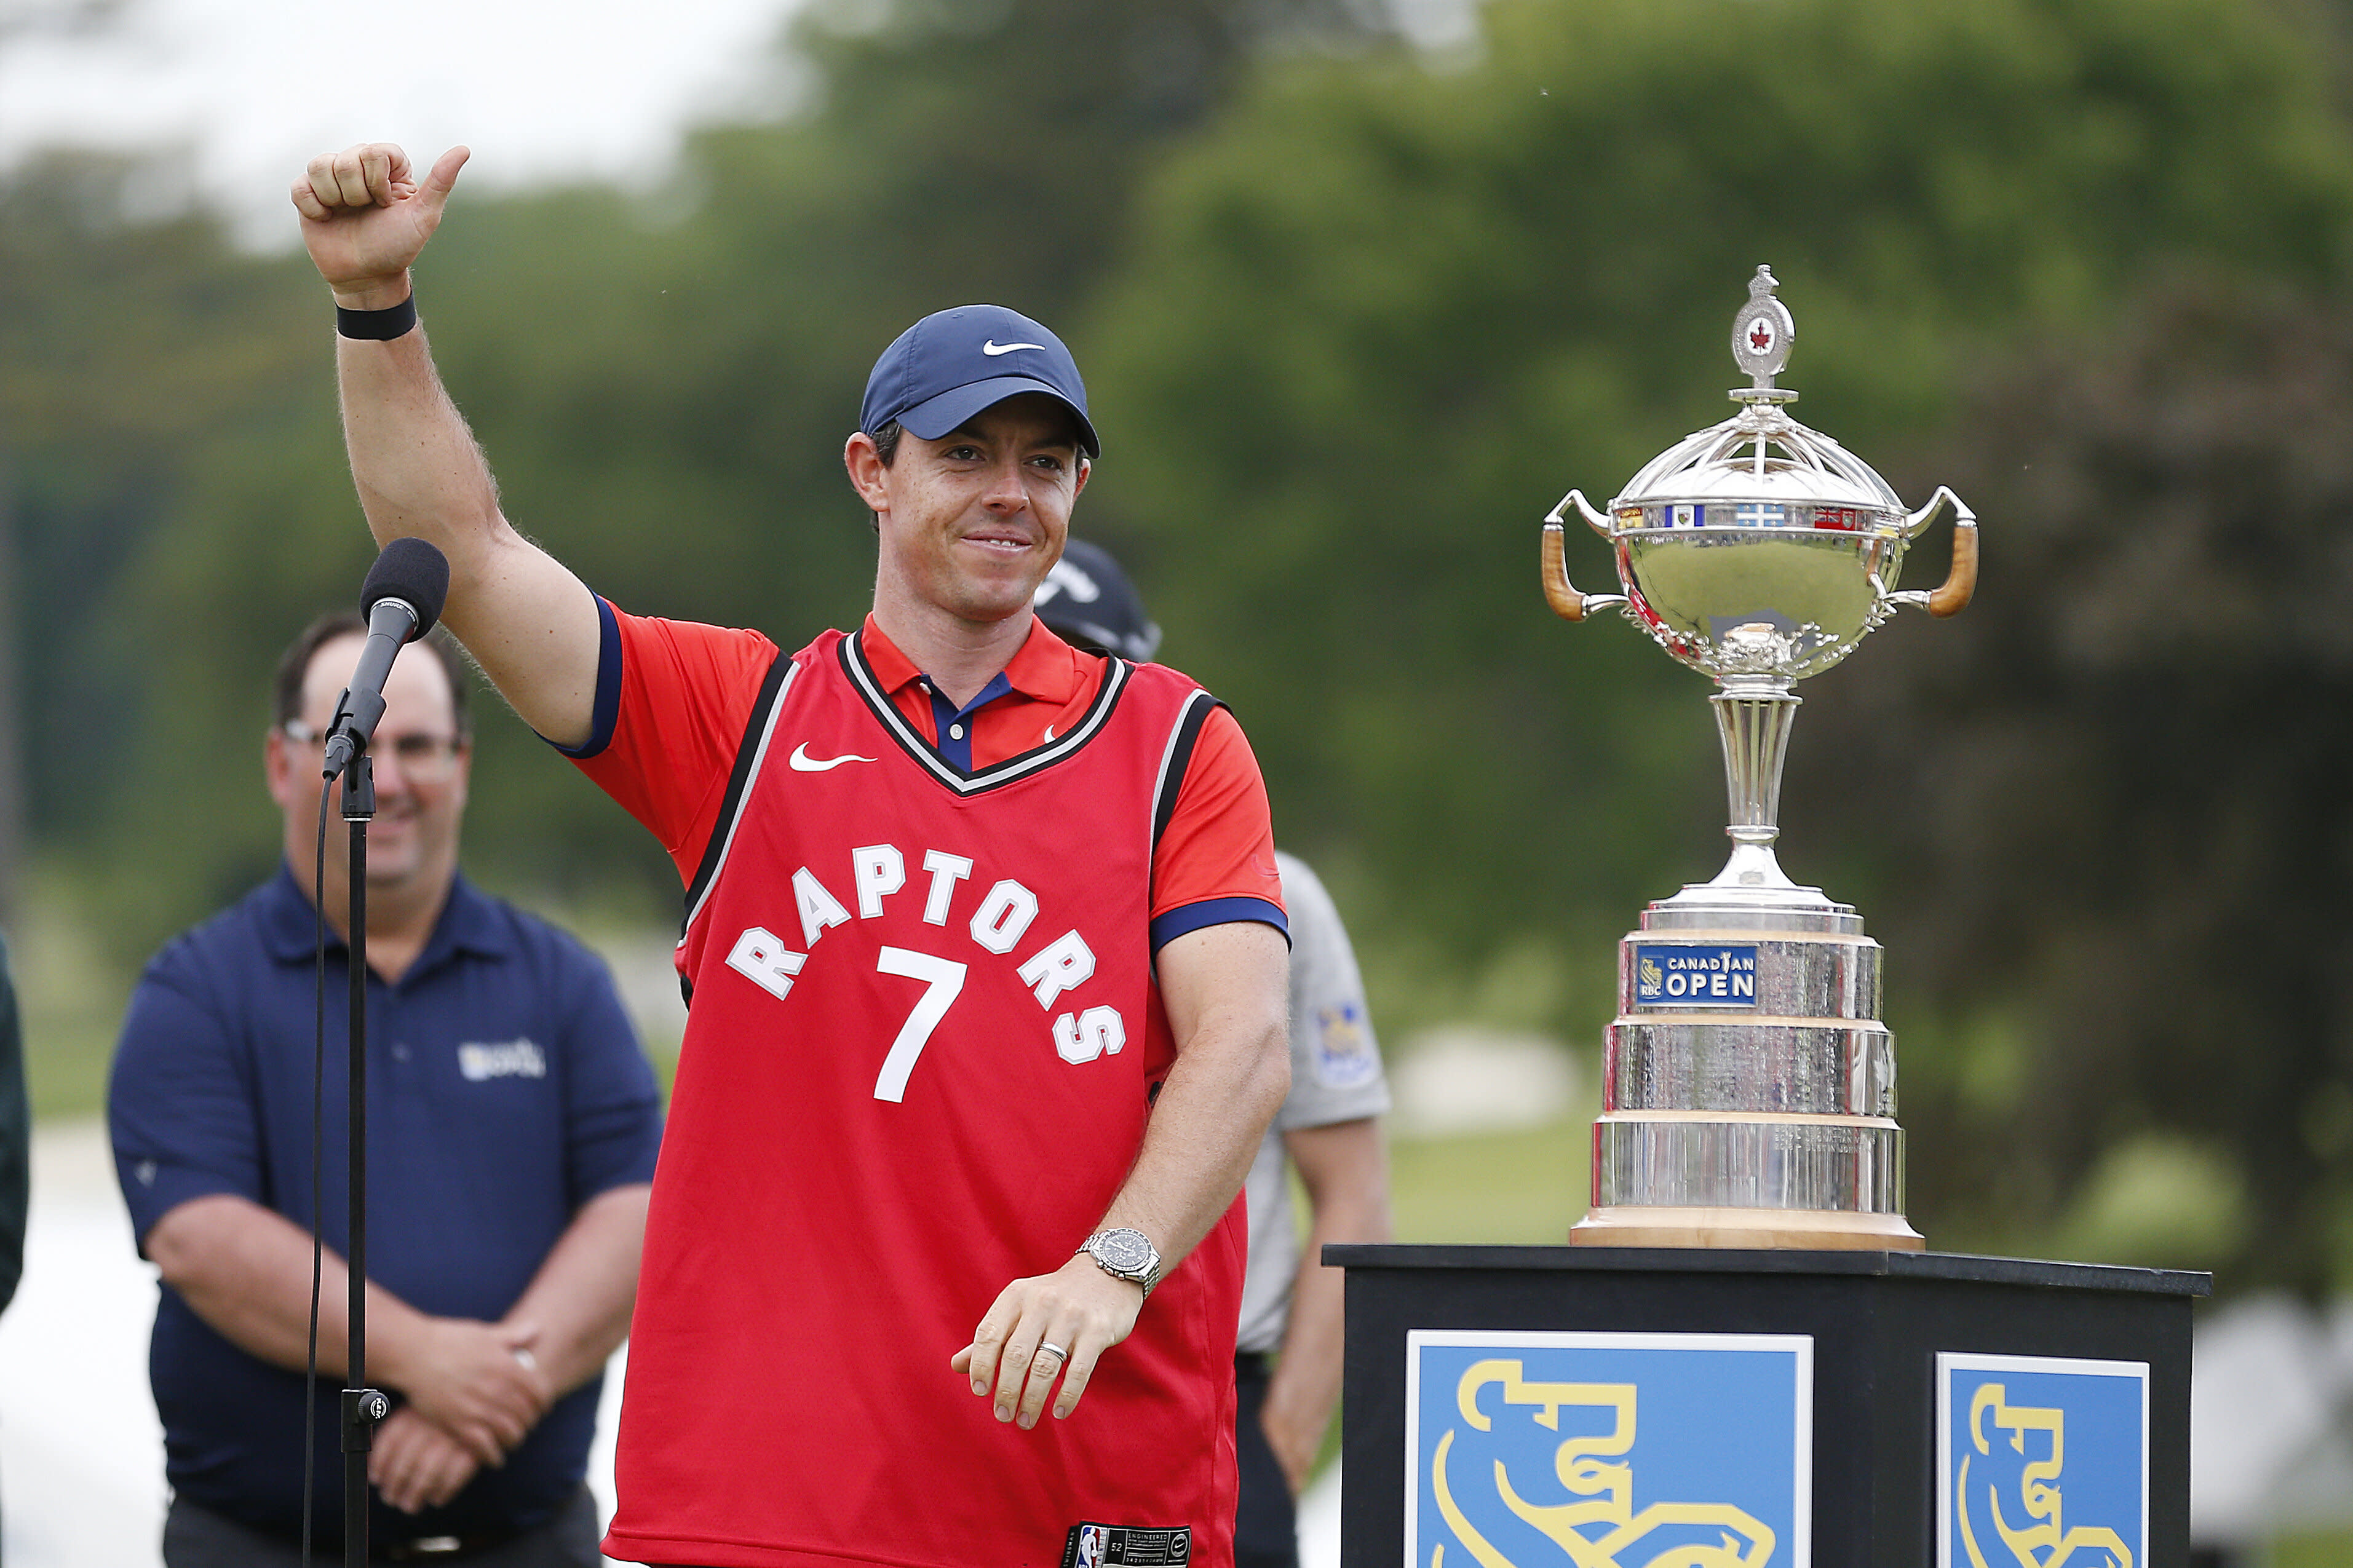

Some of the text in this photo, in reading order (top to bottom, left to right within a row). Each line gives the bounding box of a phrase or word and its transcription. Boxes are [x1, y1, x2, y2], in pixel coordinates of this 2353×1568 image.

[725, 843, 1125, 1065] RAPTORS
[1667, 952, 1754, 974] CANADIAN
[1641, 986, 1662, 996] RBC
[1666, 973, 1754, 996] OPEN
[873, 945, 967, 1103] 7
[1111, 1542, 1122, 1552] 52
